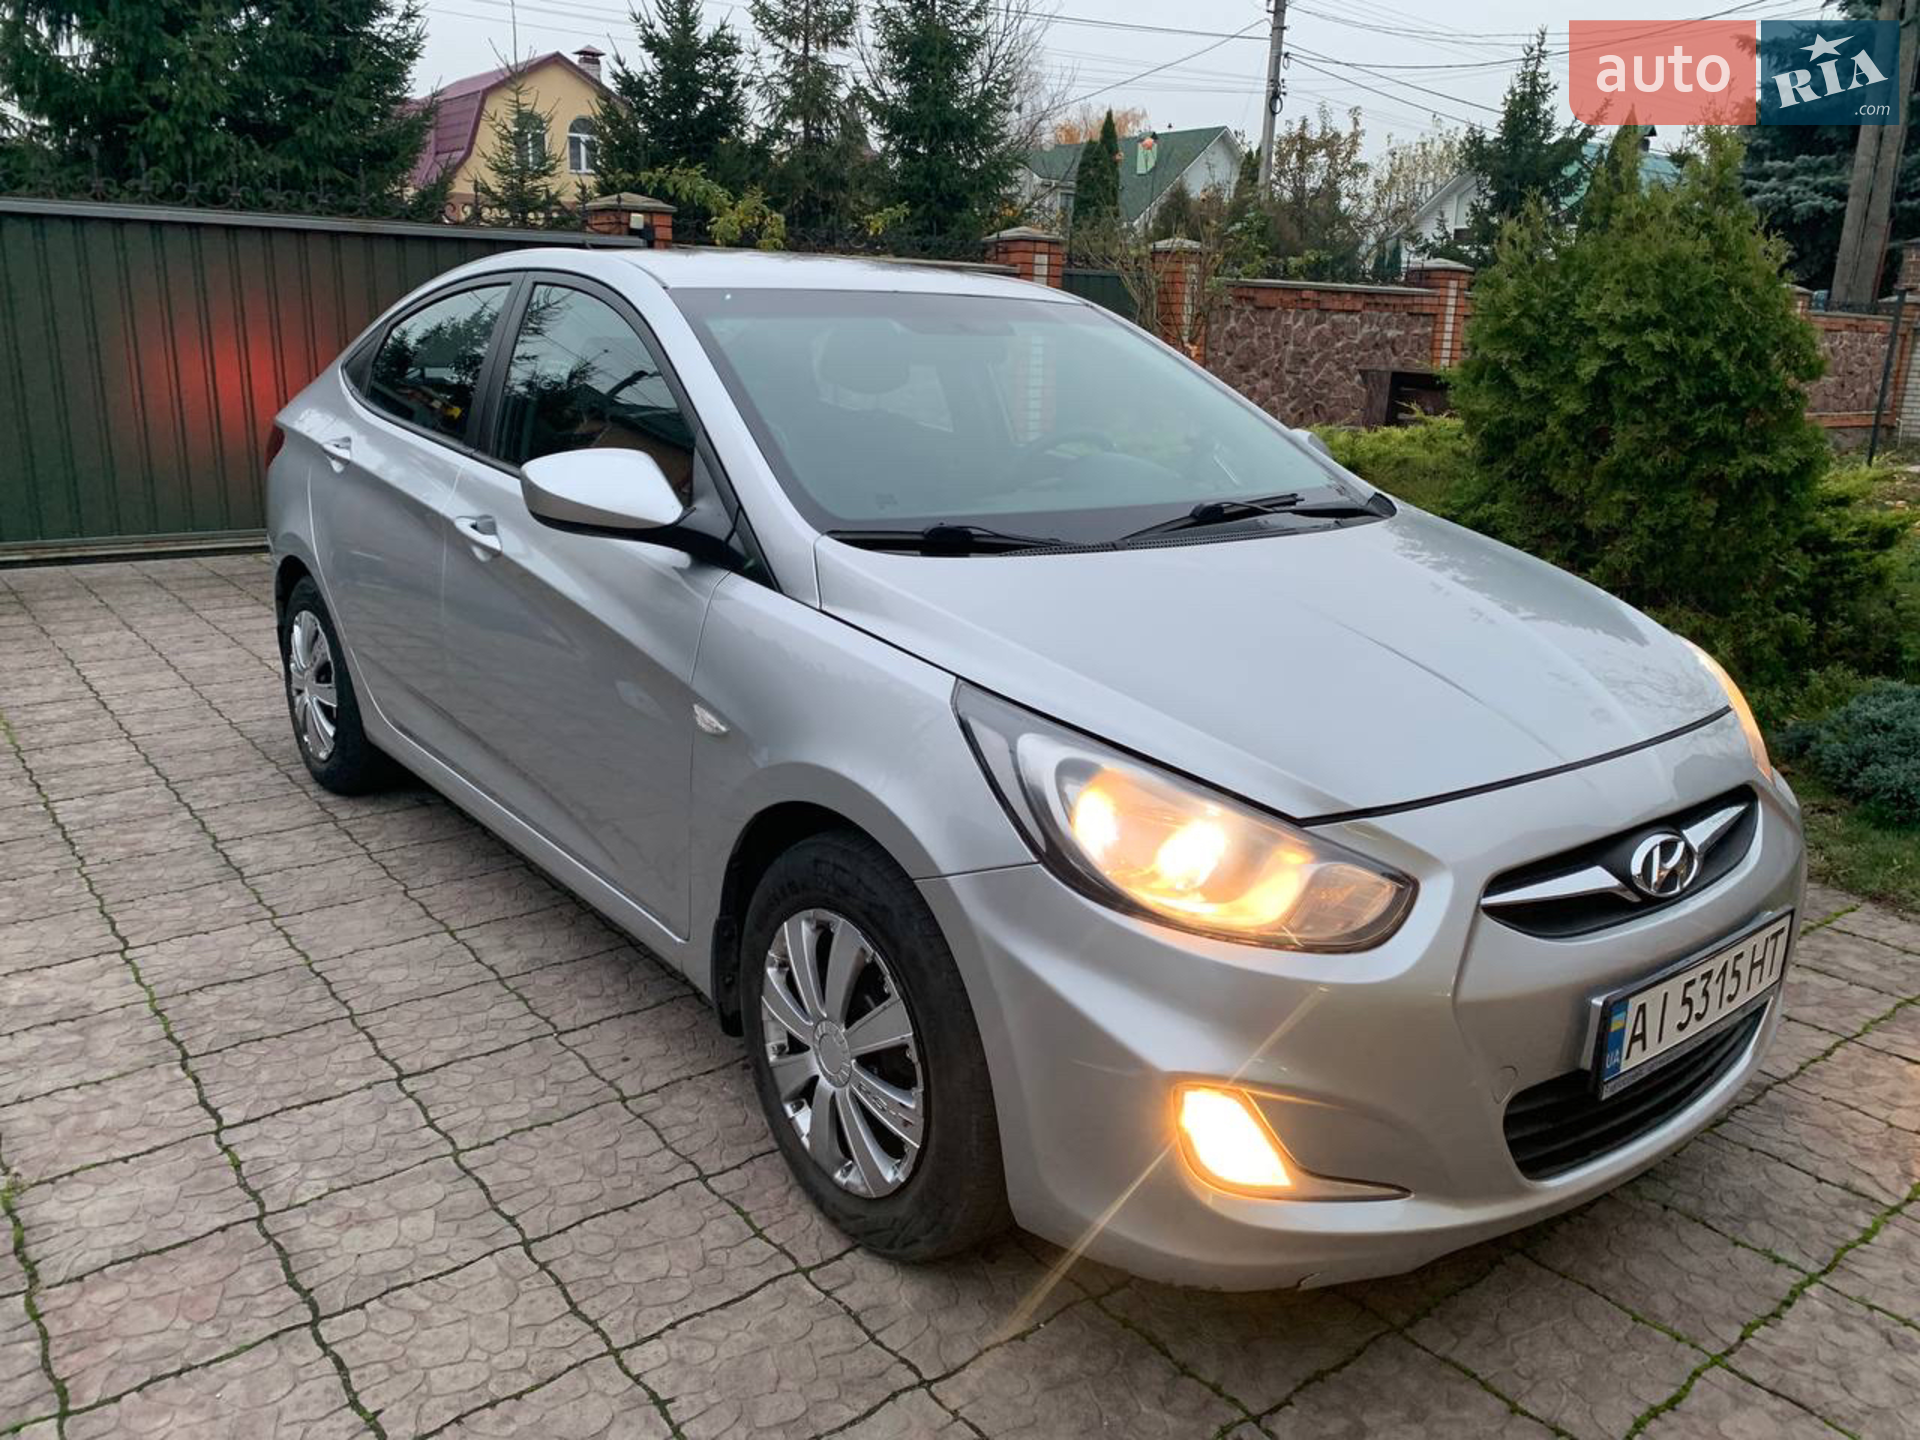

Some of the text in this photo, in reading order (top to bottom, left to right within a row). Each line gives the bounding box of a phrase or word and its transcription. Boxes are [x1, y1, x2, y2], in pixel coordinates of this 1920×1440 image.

[1625, 926, 1786, 1060] AI 5315 HT
